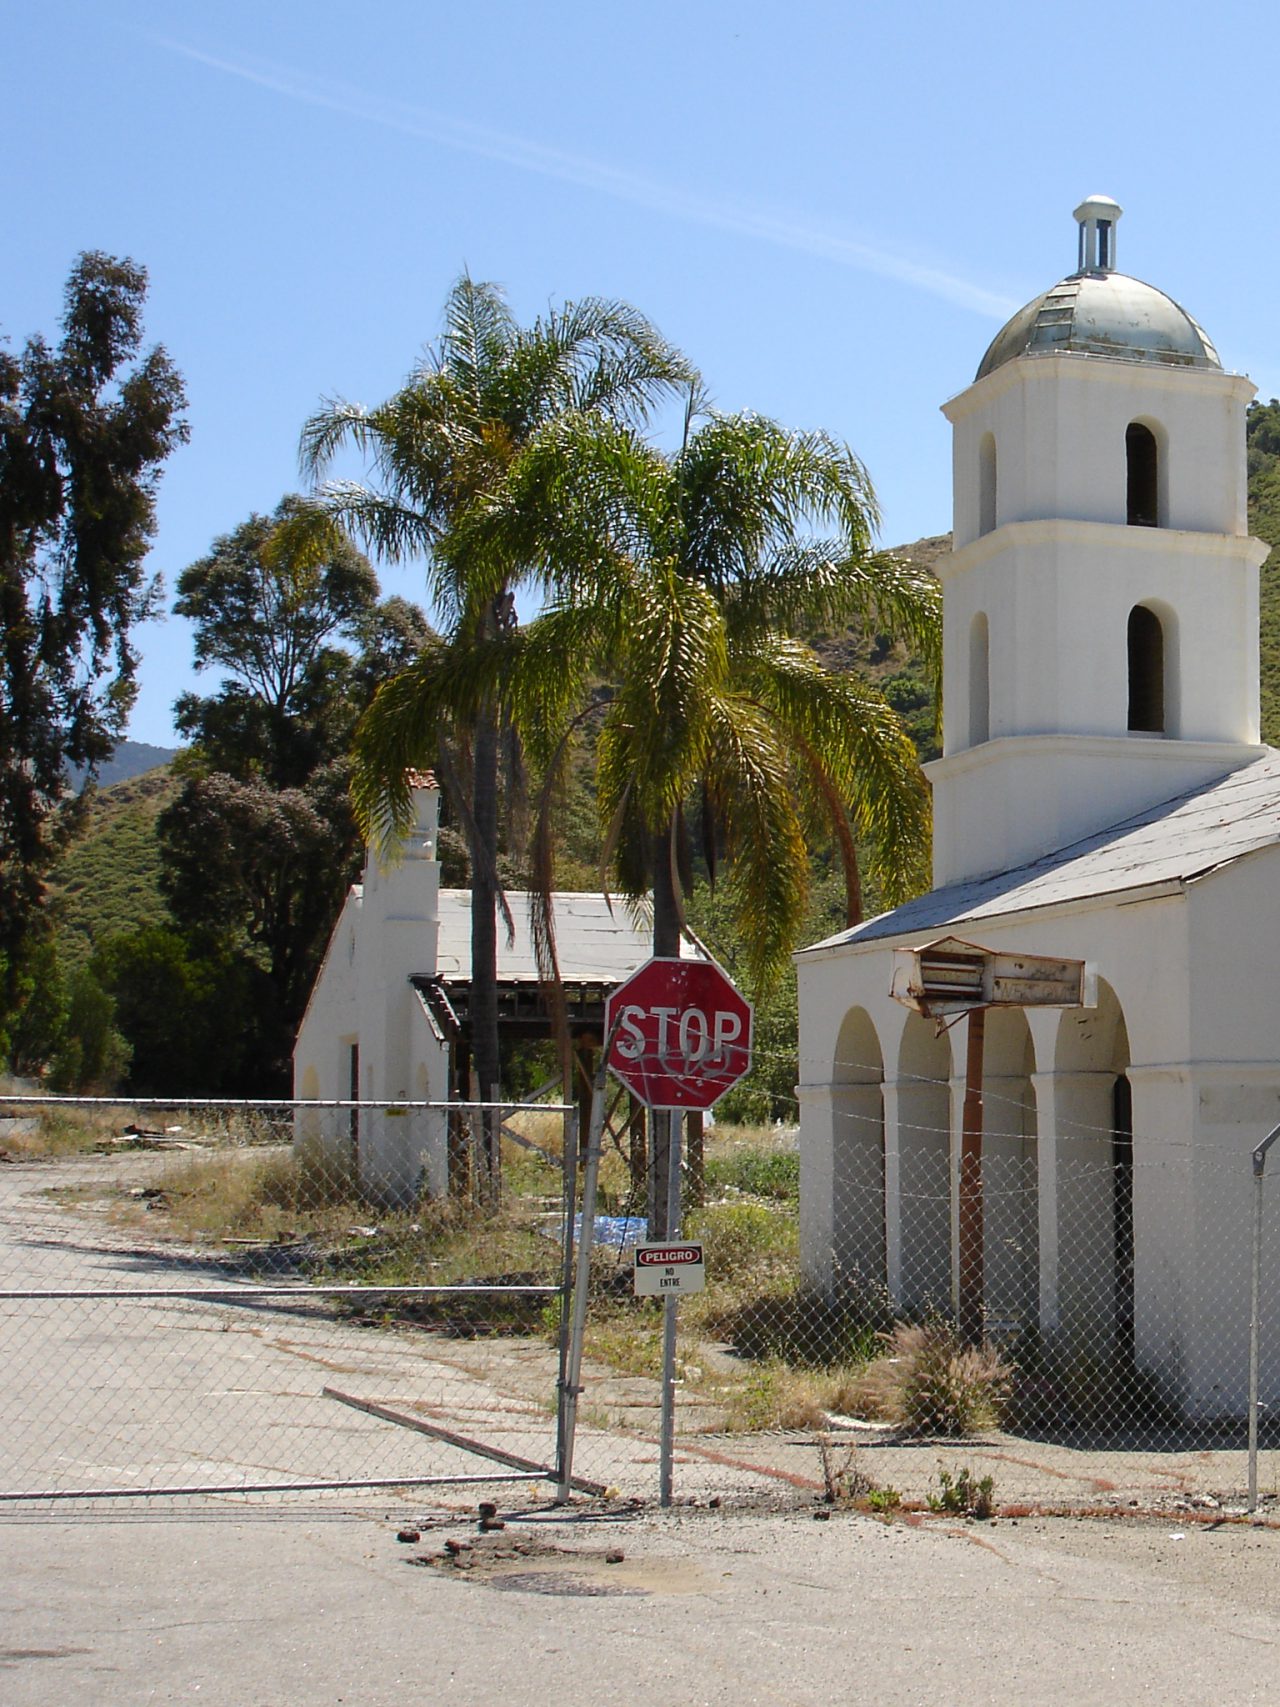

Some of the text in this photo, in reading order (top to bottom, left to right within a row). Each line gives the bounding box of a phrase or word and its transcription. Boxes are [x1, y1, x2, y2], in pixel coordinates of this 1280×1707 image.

[616, 1005, 741, 1062] STOP
[645, 1251, 693, 1262] PELIGRO
[665, 1267, 674, 1276] NO
[660, 1278, 680, 1287] ENTRE
